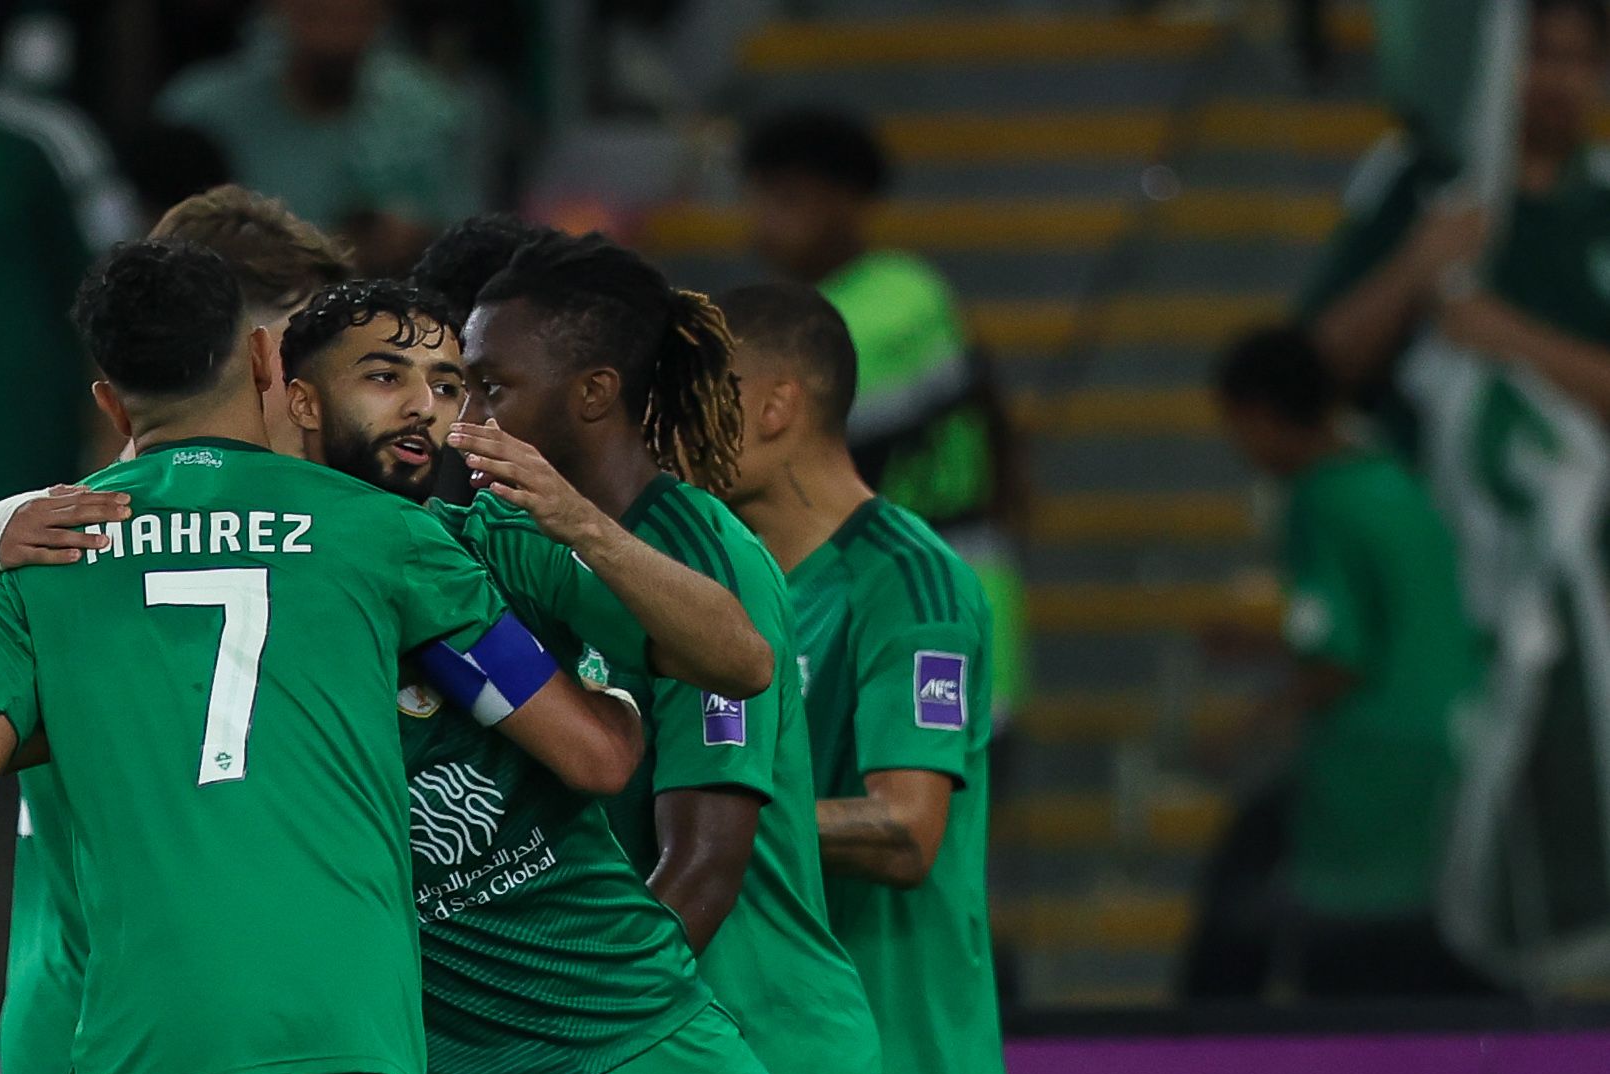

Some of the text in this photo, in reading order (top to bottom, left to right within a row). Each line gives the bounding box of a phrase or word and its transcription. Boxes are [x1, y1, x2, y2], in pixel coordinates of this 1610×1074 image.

[85, 511, 313, 565] MAHREZ
[144, 567, 270, 786] 7
[920, 677, 958, 702] AFC
[511, 826, 545, 864] البحر
[415, 870, 464, 904] الدولي
[489, 846, 557, 896] Global
